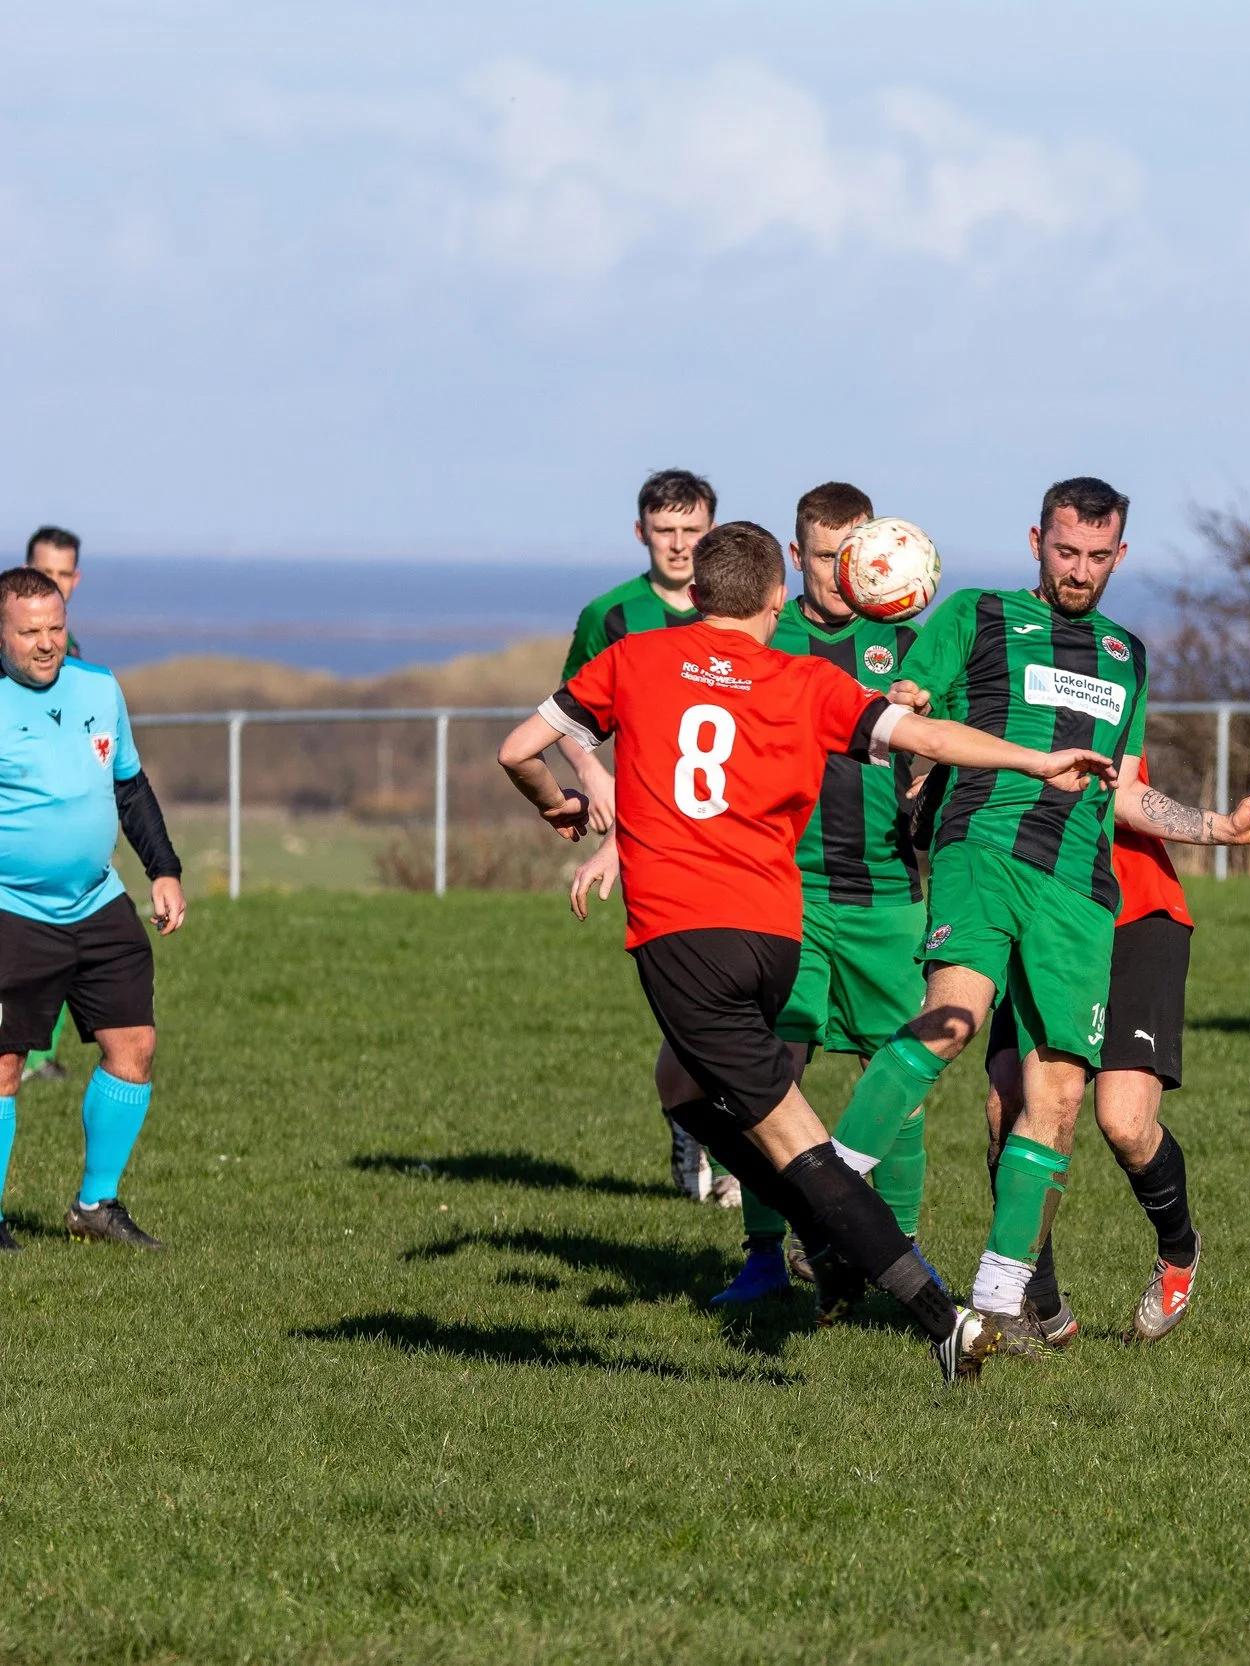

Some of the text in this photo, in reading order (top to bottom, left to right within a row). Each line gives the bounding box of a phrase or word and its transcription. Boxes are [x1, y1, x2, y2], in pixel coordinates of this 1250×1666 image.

[680, 671, 715, 687] cleaning
[682, 662, 699, 673] RG
[1054, 672, 1112, 696] Lakeland
[1054, 684, 1120, 712] Verandahs
[674, 704, 736, 820] 8
[1091, 1002, 1105, 1032] 19
